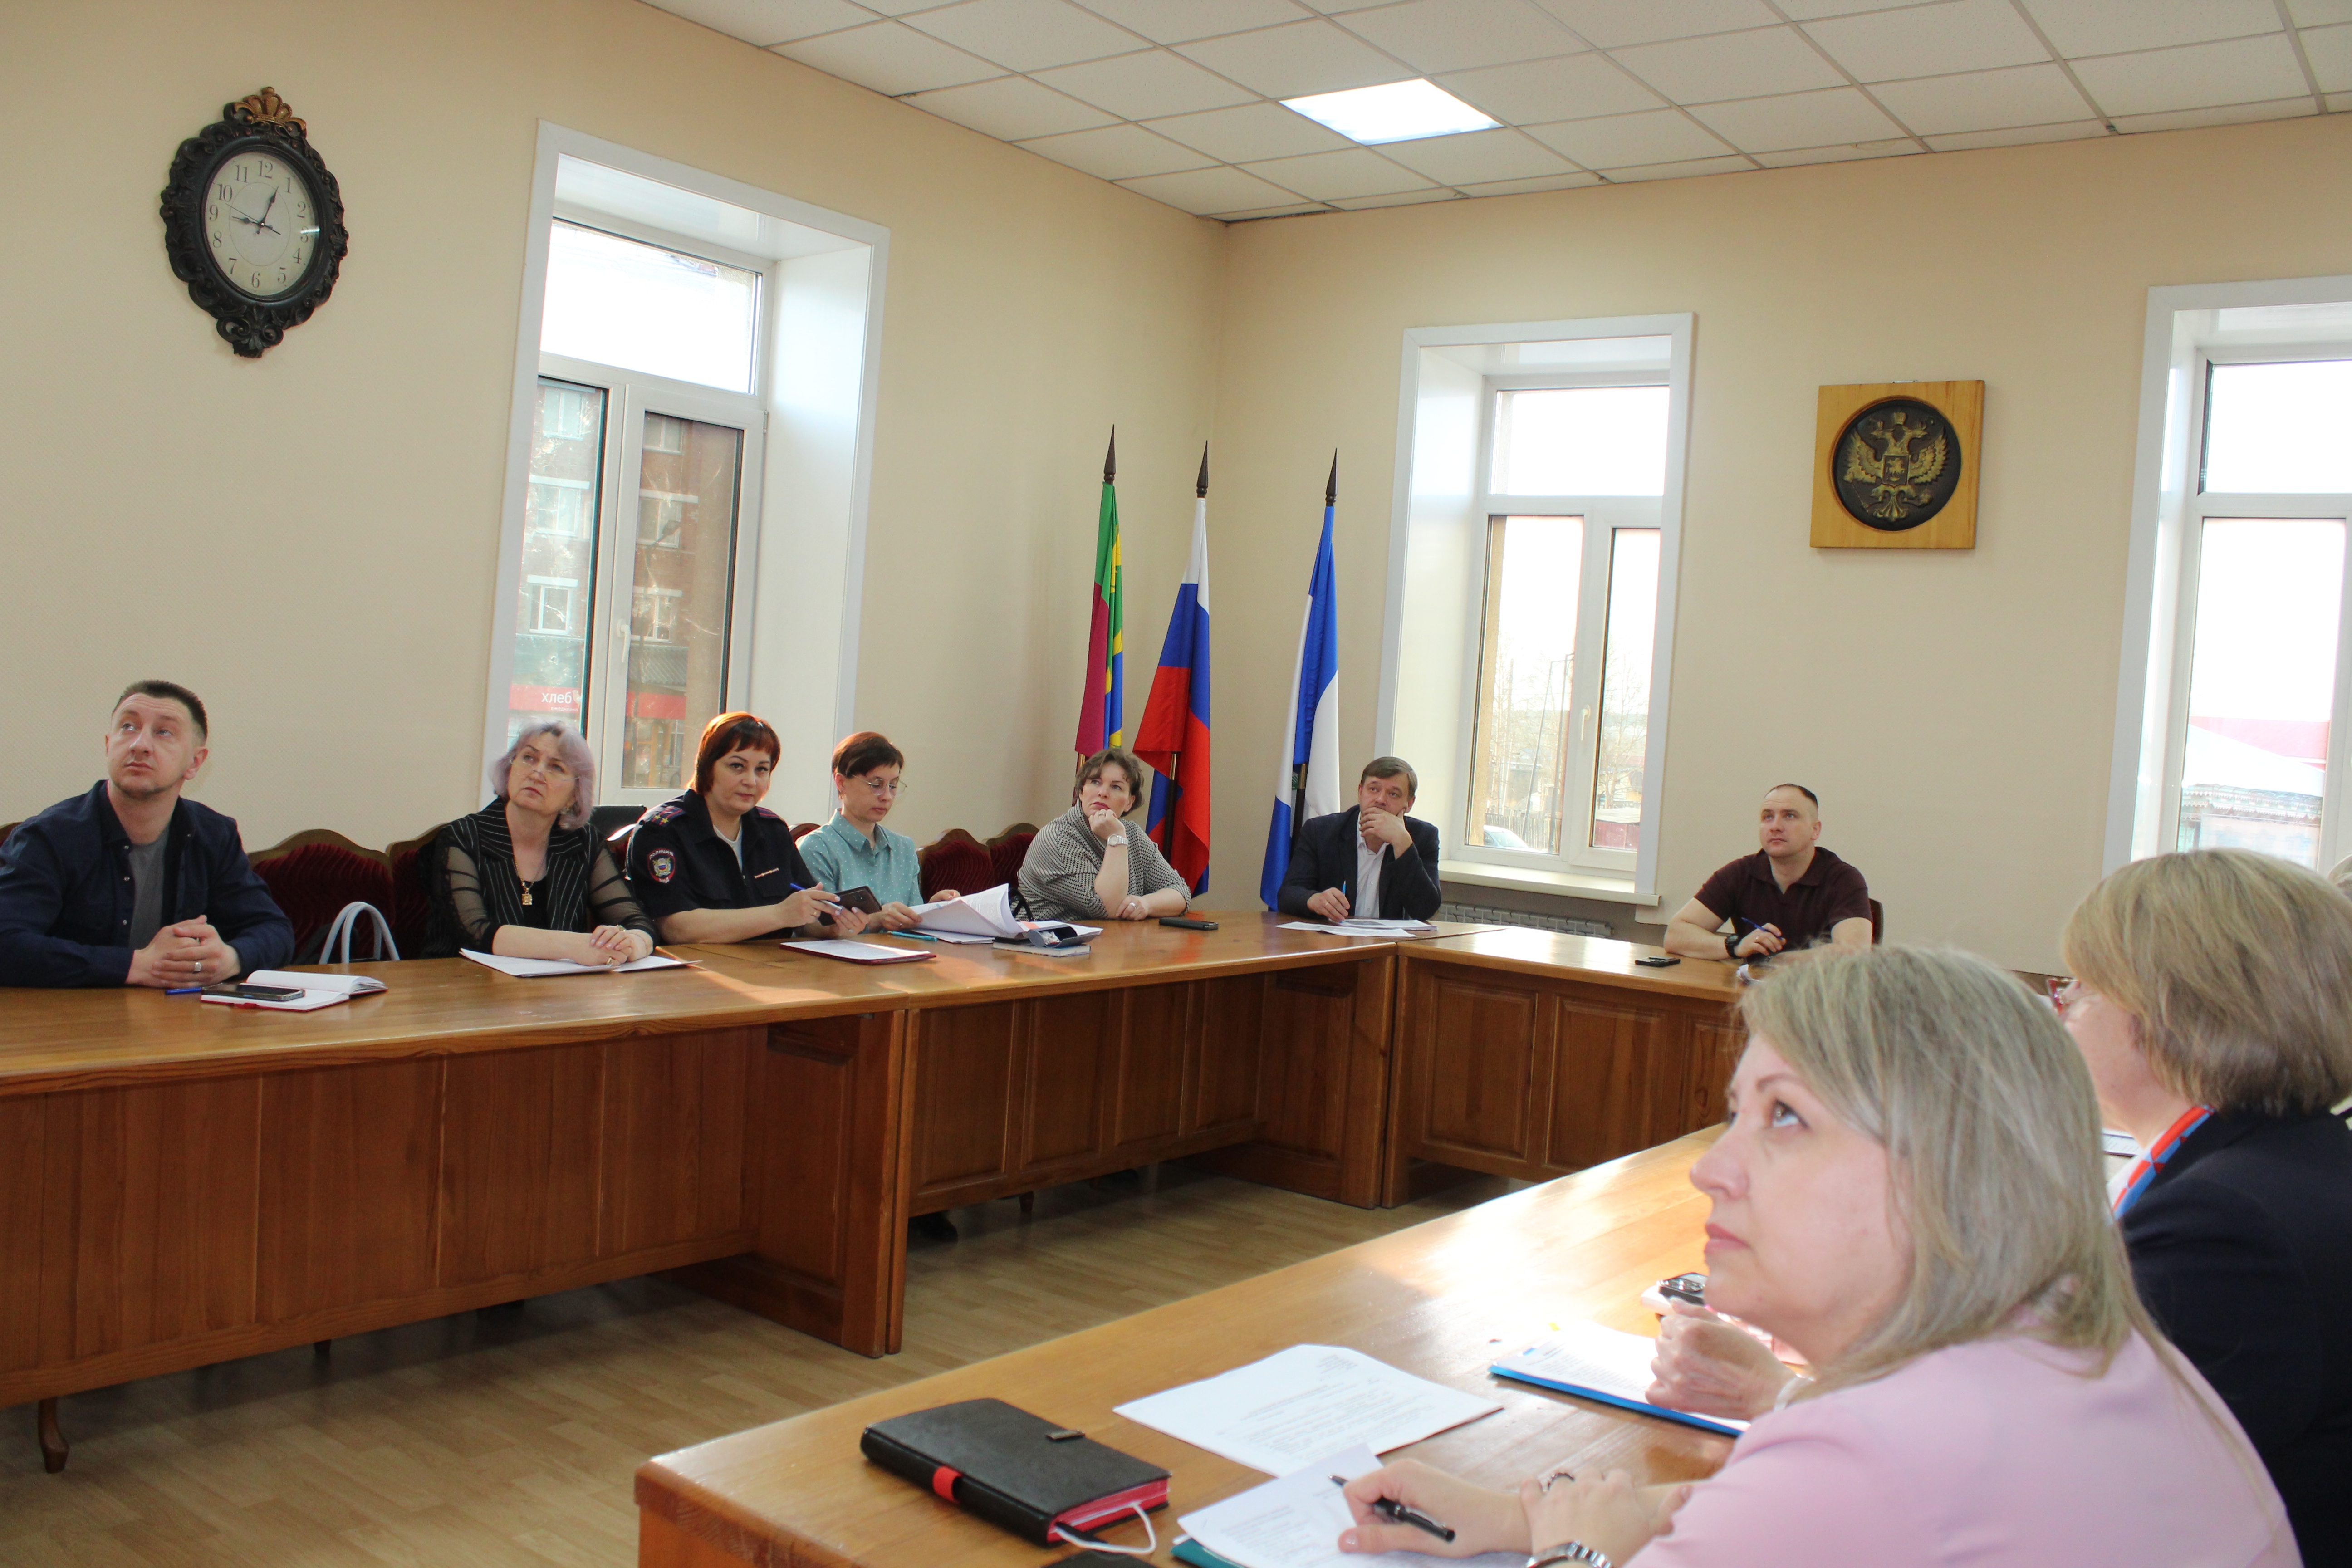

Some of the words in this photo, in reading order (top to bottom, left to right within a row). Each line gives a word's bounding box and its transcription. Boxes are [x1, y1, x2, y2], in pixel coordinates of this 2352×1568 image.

[234, 165, 250, 184] 11
[258, 160, 273, 179] 12
[217, 184, 233, 202] 10
[284, 177, 292, 194] 1
[209, 205, 218, 222] 9
[297, 201, 306, 218] 2
[213, 230, 222, 248] 8
[300, 226, 309, 243] 3
[293, 248, 302, 265] 4
[229, 257, 237, 274] 7
[252, 271, 260, 289] 6
[278, 267, 286, 284] 5
[541, 692, 572, 704] хлеб
[649, 850, 673, 860] ПОЛИЦИЯ
